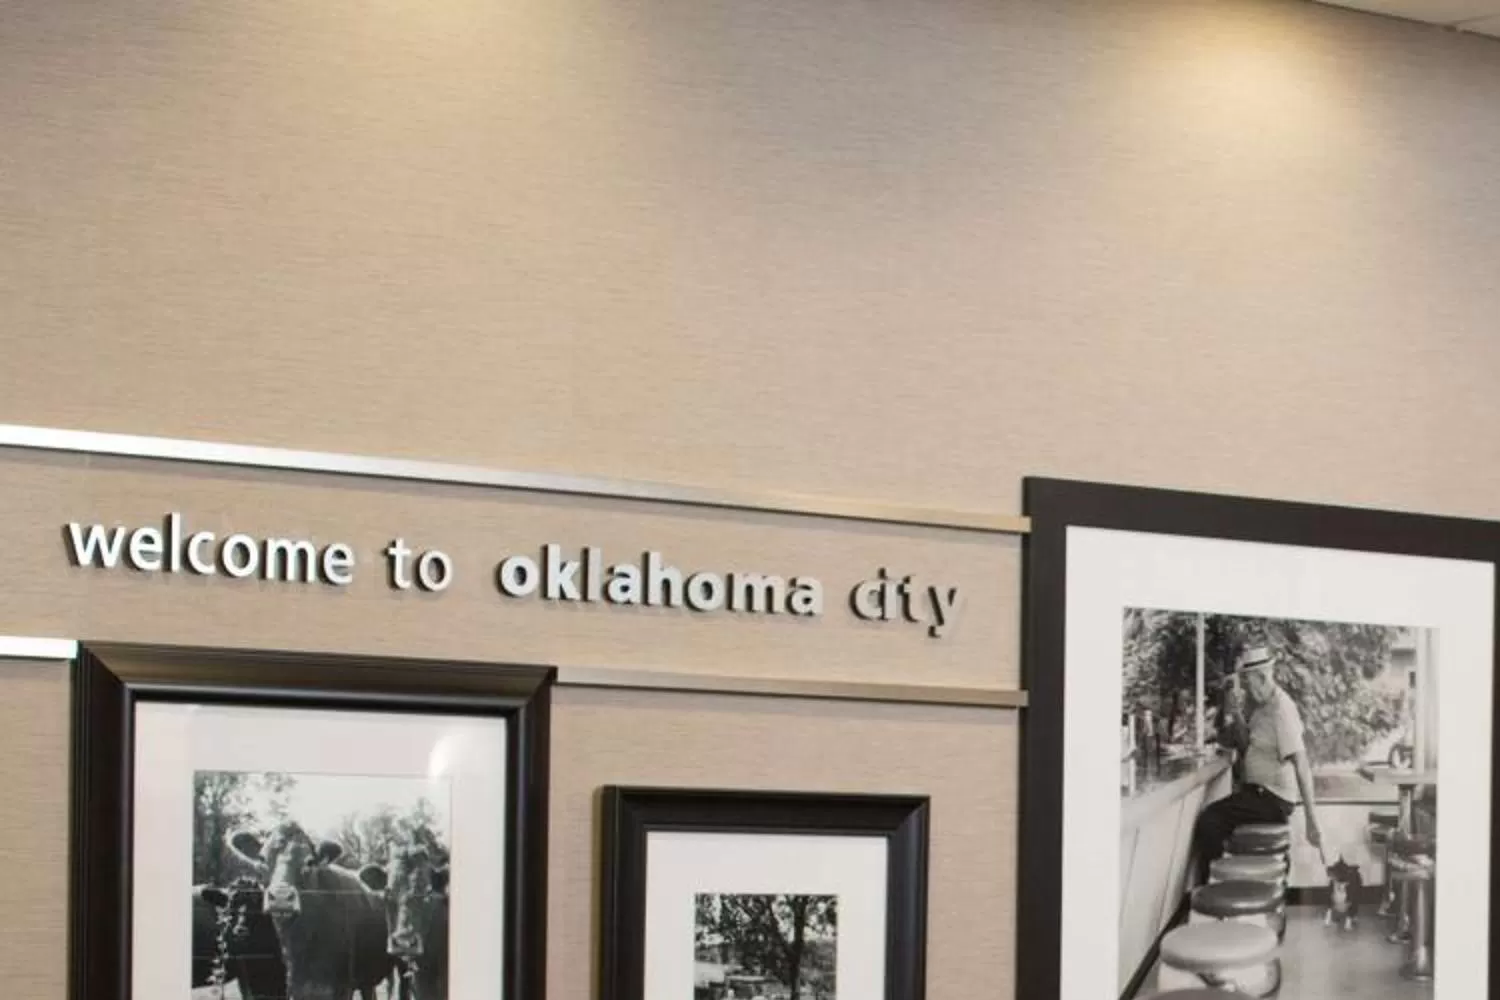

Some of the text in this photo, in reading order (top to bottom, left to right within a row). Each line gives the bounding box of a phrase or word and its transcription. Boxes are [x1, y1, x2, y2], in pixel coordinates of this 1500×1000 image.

[65, 511, 958, 639] welcome to oklahoma city
